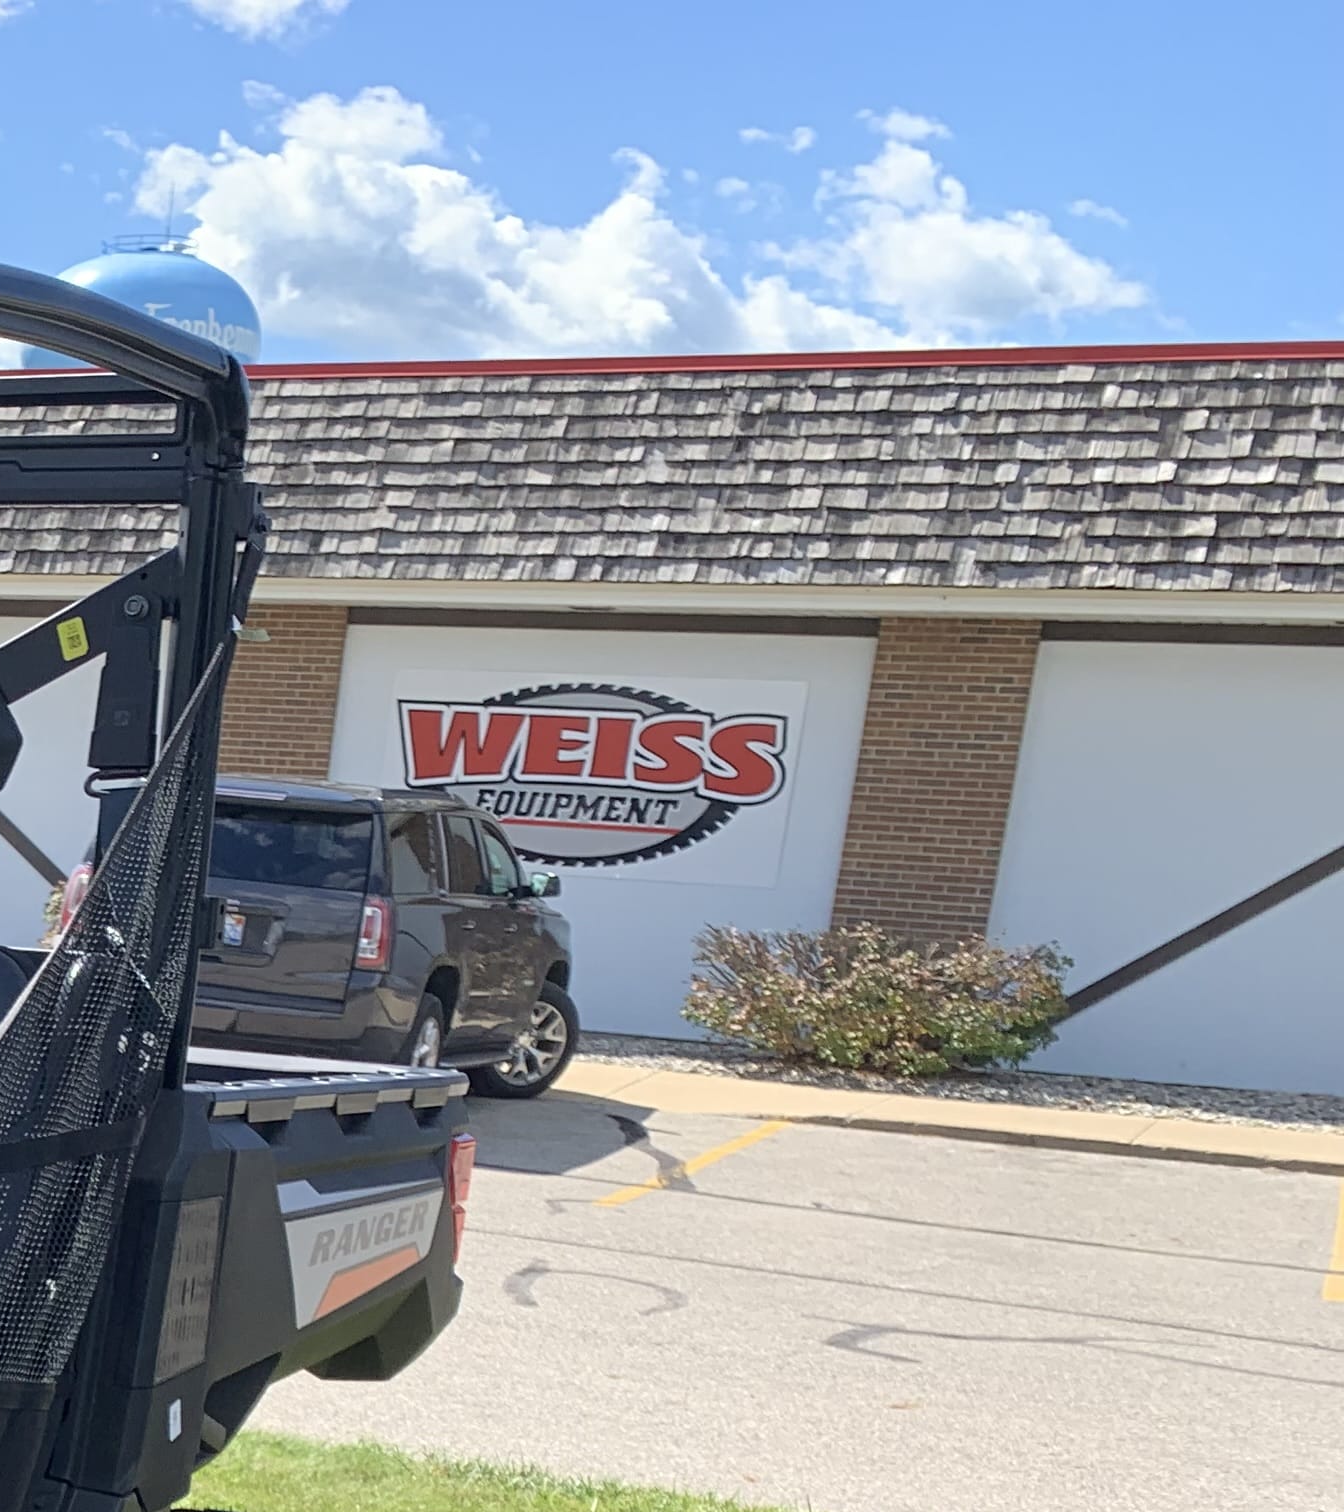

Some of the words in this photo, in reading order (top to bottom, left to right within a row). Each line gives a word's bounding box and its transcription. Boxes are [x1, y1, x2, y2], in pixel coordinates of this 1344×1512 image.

[404, 703, 782, 803] WEISS
[477, 788, 679, 825] EQUIPMENT
[308, 1201, 430, 1267] RANGER
